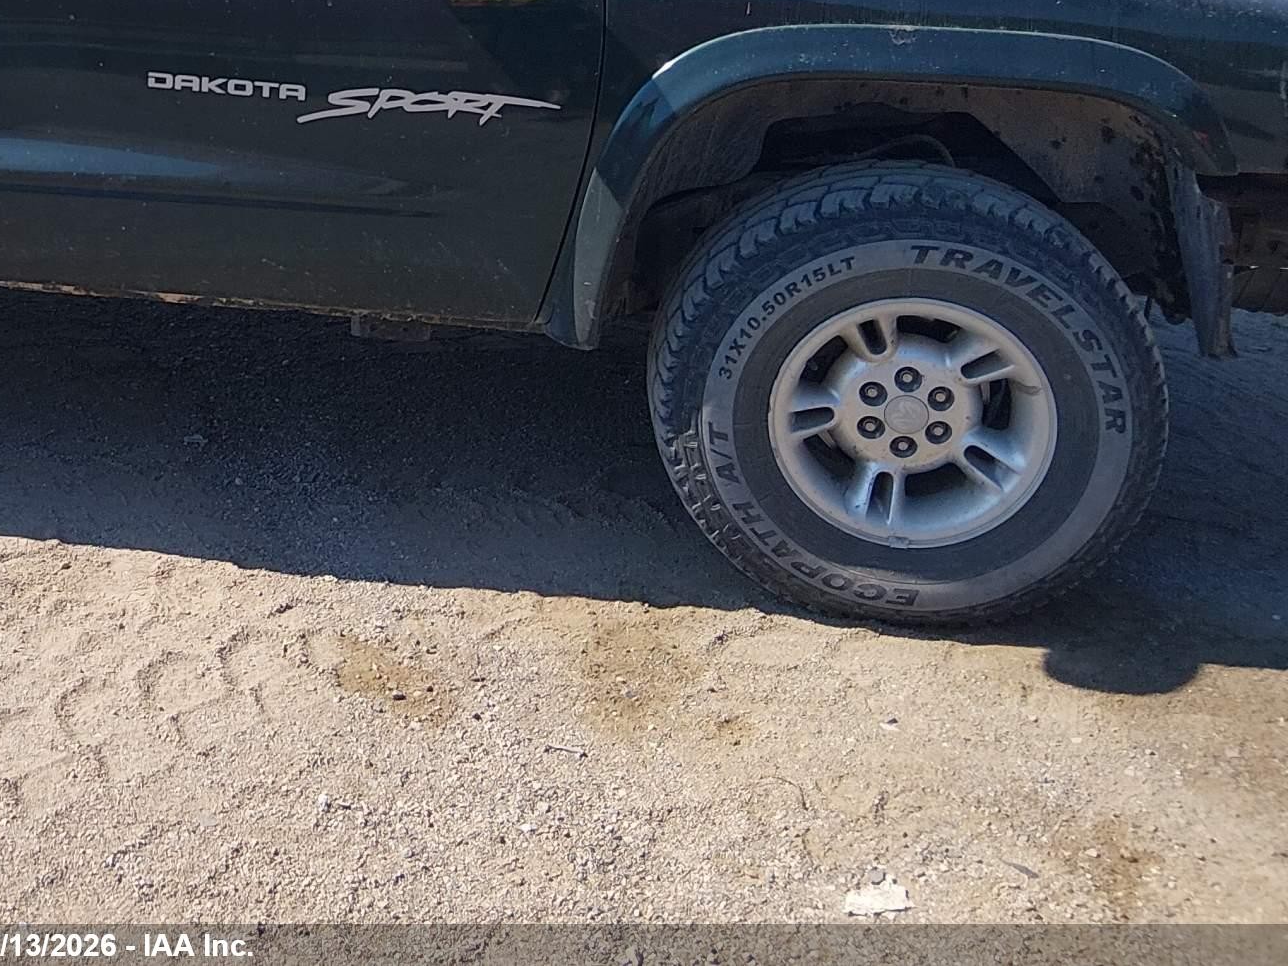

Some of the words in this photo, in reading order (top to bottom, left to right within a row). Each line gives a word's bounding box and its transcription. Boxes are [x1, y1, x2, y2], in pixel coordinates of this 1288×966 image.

[147, 71, 307, 102] DAKOTA
[296, 87, 562, 126] SPORT
[718, 255, 857, 381] 31X10.50R15LT
[909, 244, 1129, 434] TRAVELSTAR
[707, 420, 742, 487] A/T
[730, 495, 920, 607] ECOPATH
